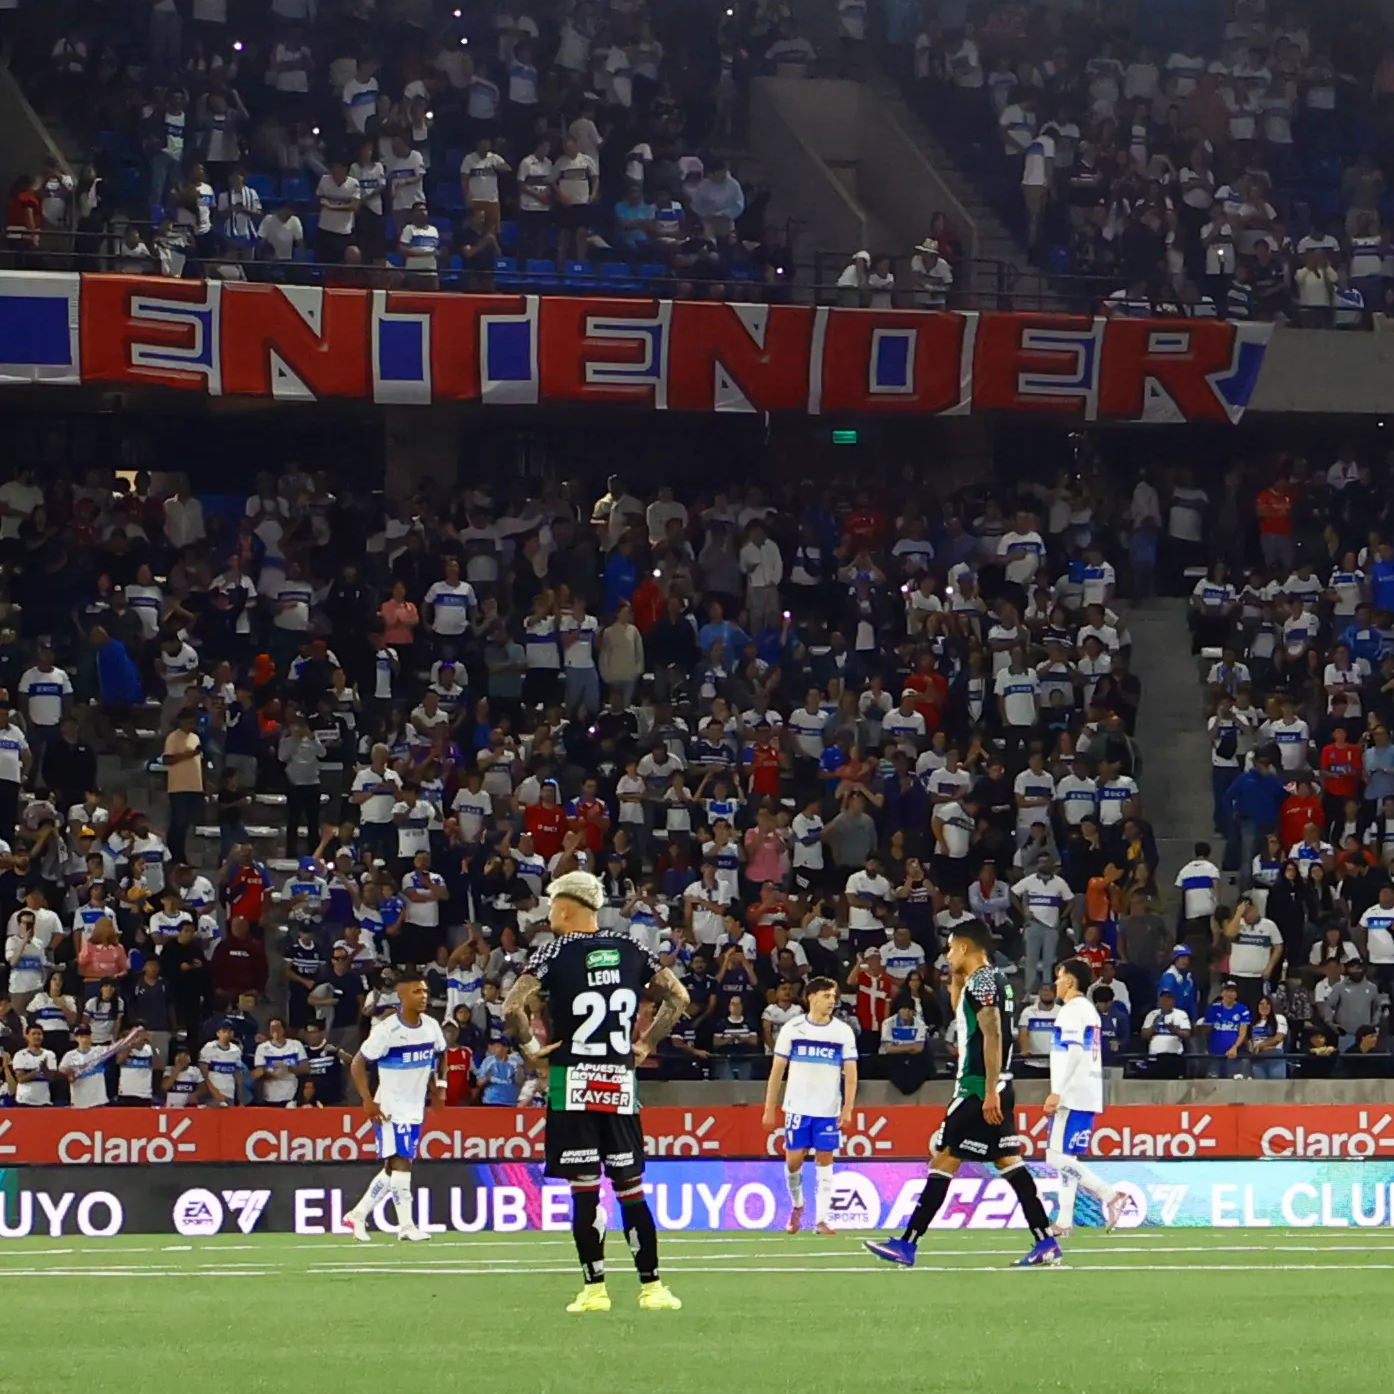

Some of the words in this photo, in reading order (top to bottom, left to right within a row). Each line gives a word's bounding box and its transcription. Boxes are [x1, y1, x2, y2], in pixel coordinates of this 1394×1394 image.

[81, 272, 1240, 424] ENTENDER
[587, 969, 621, 987] LEON
[570, 987, 637, 1056] 23
[808, 1046, 835, 1059] BICE
[572, 1090, 630, 1107] KAYSER
[58, 1130, 175, 1163] Claro
[245, 1130, 358, 1161] Claro
[420, 1130, 531, 1160] Claro
[643, 1134, 699, 1156] aro
[1090, 1127, 1197, 1156] Claro
[1260, 1126, 1377, 1157] Claro
[372, 1186, 526, 1234] CLUB
[1211, 1183, 1272, 1227] EL
